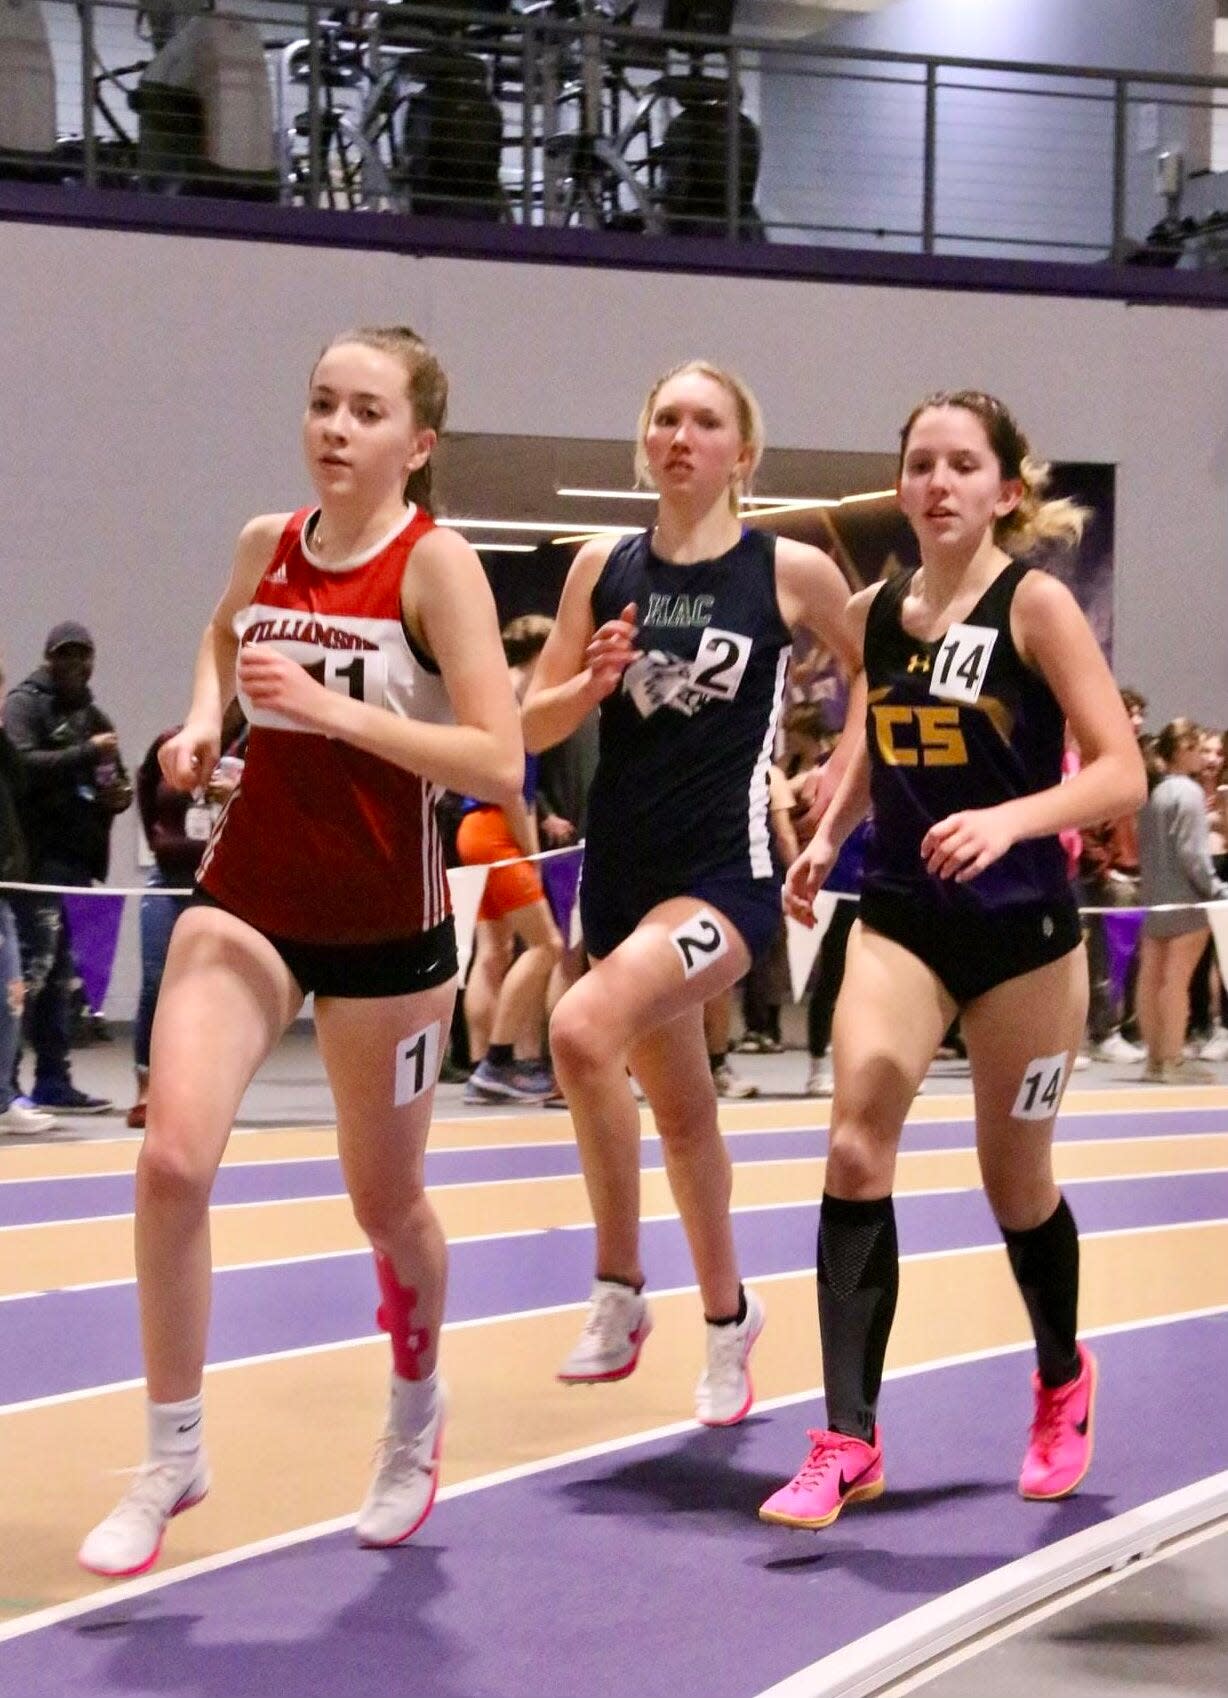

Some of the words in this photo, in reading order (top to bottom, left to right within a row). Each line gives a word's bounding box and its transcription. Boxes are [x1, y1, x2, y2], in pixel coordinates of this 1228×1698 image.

[643, 592, 716, 627] HAC
[335, 657, 364, 703] 1
[694, 638, 740, 693] 2
[940, 640, 985, 689] 14
[871, 704, 968, 766] CS
[678, 921, 721, 969] 2
[405, 1033, 426, 1094] 1
[1023, 1067, 1061, 1112] 14
